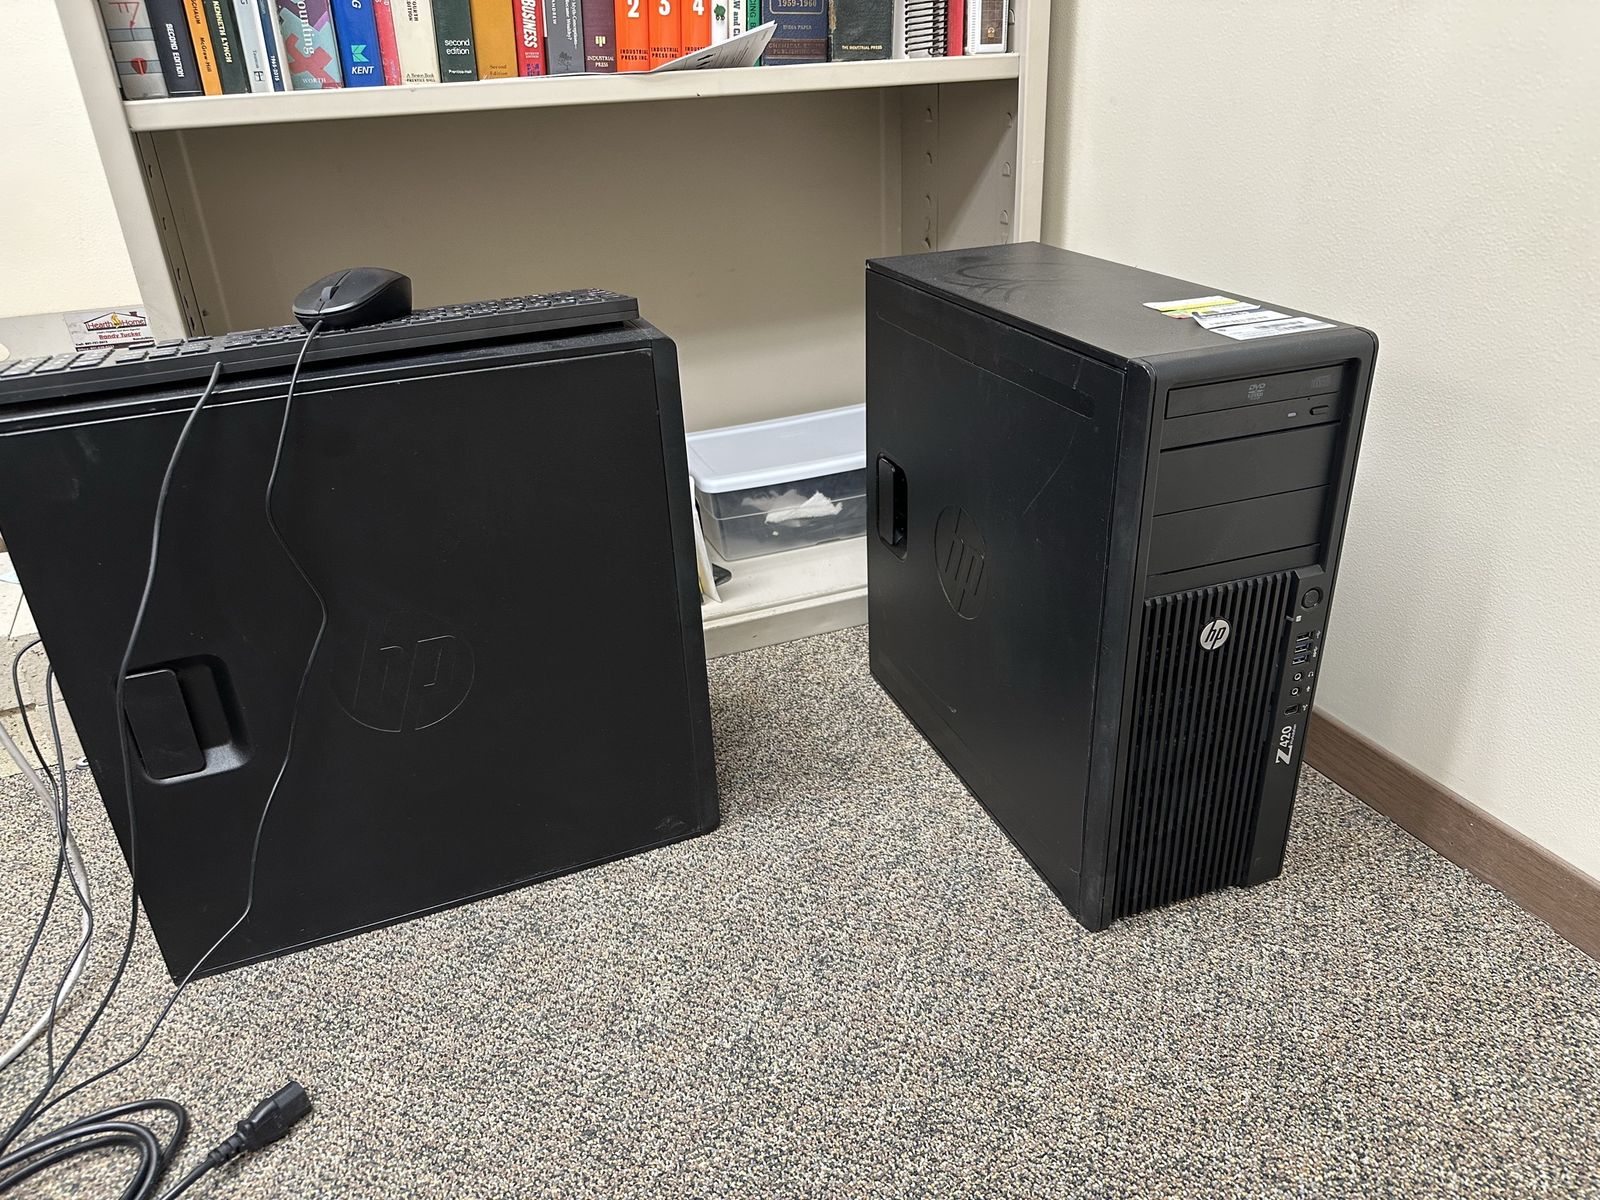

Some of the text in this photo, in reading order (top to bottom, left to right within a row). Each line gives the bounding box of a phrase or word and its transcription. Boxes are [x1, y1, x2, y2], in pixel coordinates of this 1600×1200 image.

[627, 0, 640, 17] 2
[658, 0, 671, 16] 3
[692, 0, 705, 16] 4
[212, 1, 233, 63] KENNETH LYNCH
[297, 0, 315, 55] ounting
[521, 0, 538, 48] BUSINESS
[165, 23, 184, 77] SECOND EDITION
[445, 38, 470, 46] second
[446, 47, 470, 55] edition
[352, 66, 374, 74] KENT
[87, 318, 146, 330] Hearth Home
[1204, 620, 1228, 649] hp
